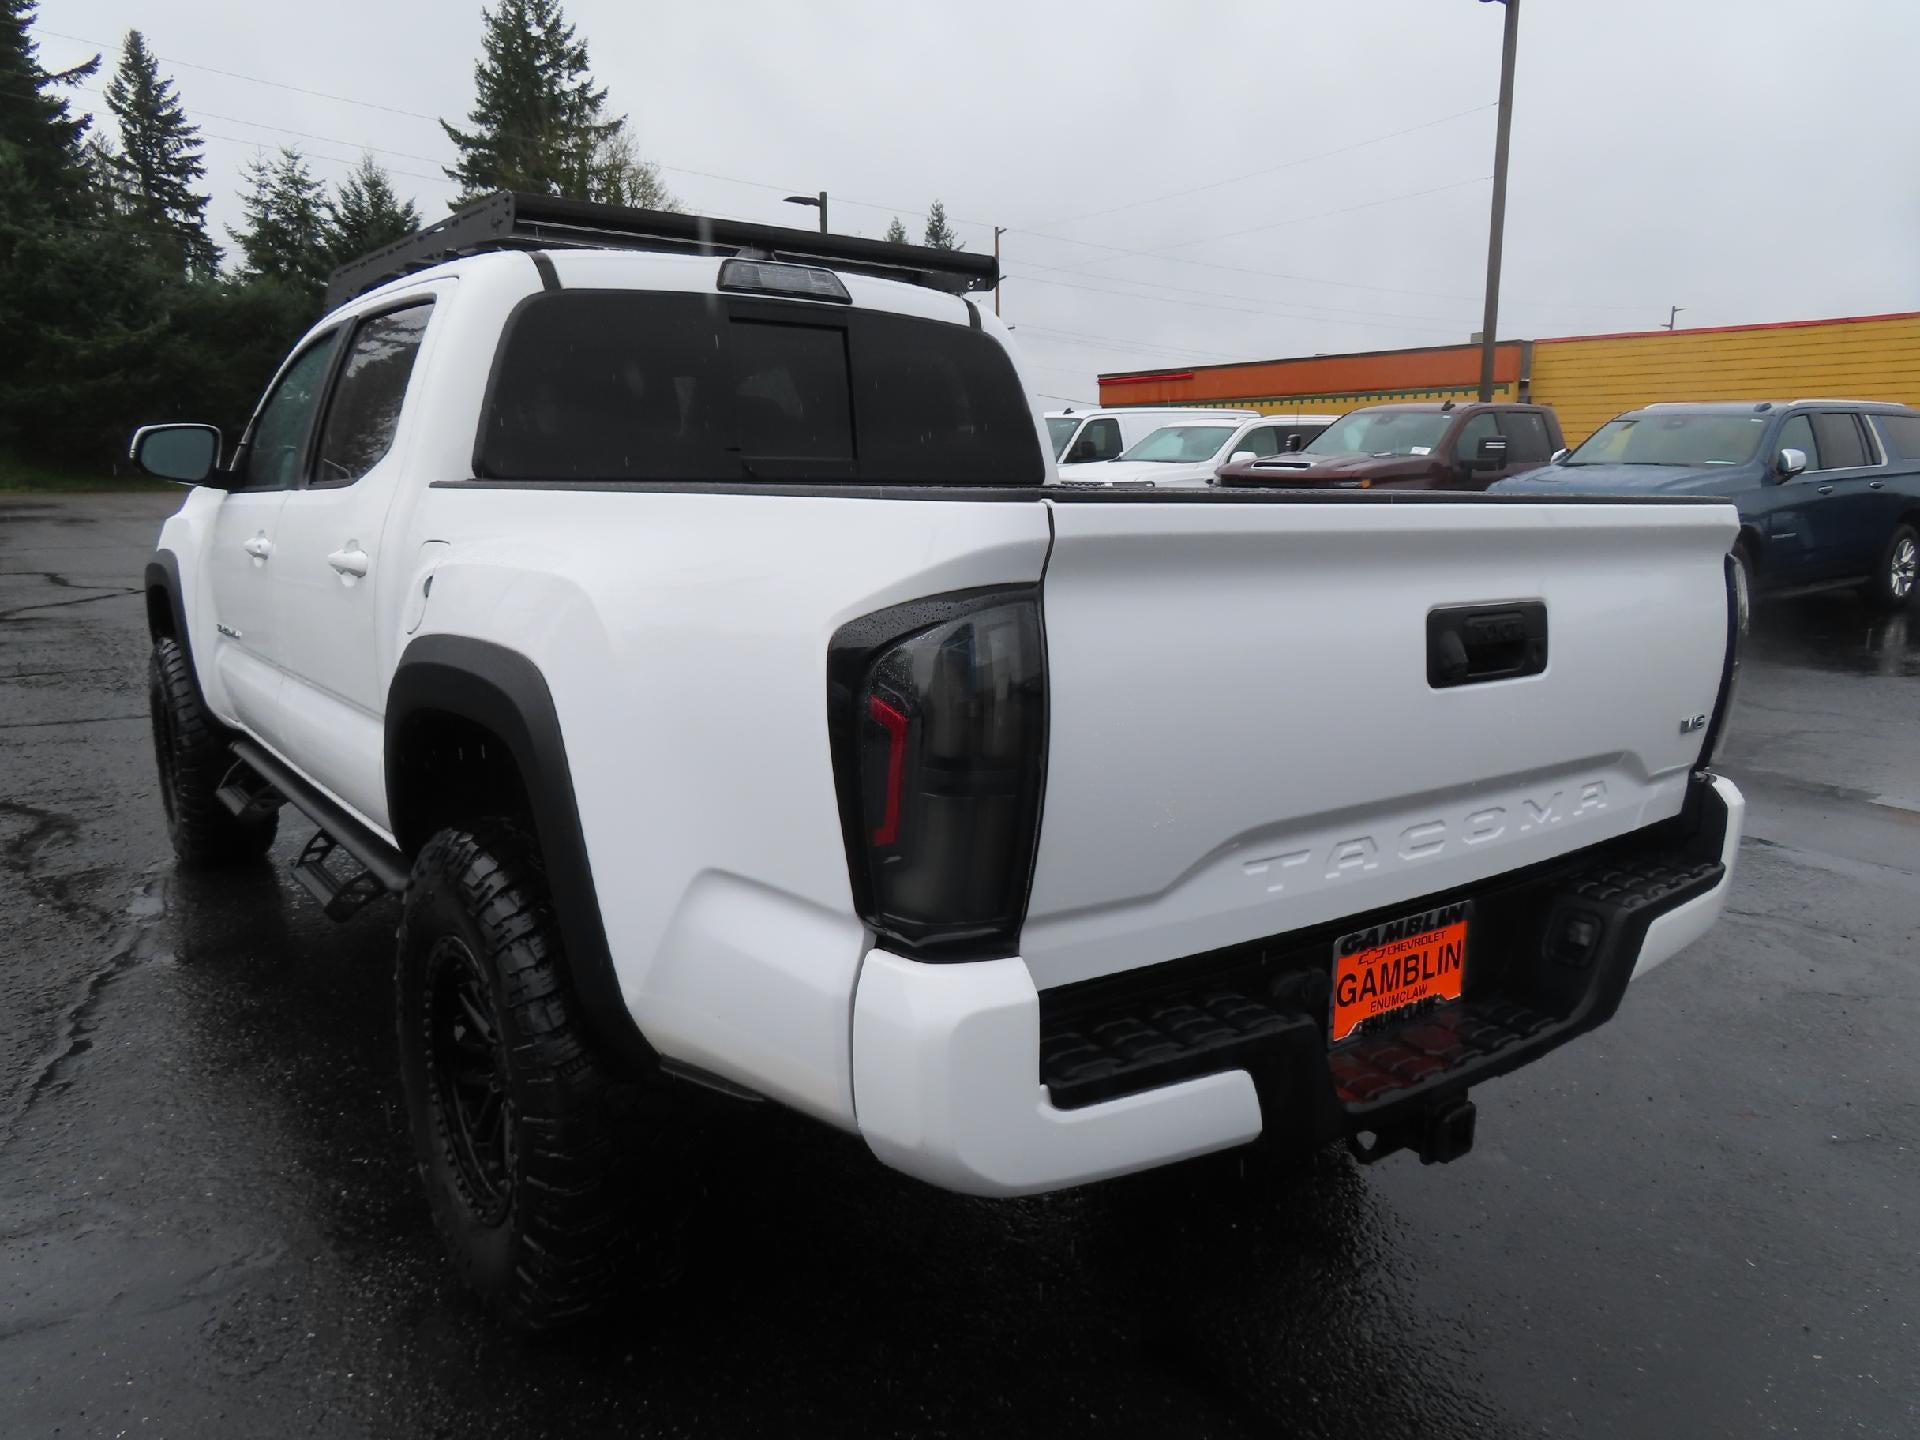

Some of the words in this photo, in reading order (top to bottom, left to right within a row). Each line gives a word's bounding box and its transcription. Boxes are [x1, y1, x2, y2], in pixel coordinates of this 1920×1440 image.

[1242, 779, 1609, 894] TACOMA
[1341, 903, 1466, 955] GAMBLIN
[1387, 930, 1447, 955] CHEVROLET
[1336, 939, 1462, 1008] GAMBLIN
[1370, 984, 1428, 1013] ENUMCLAW
